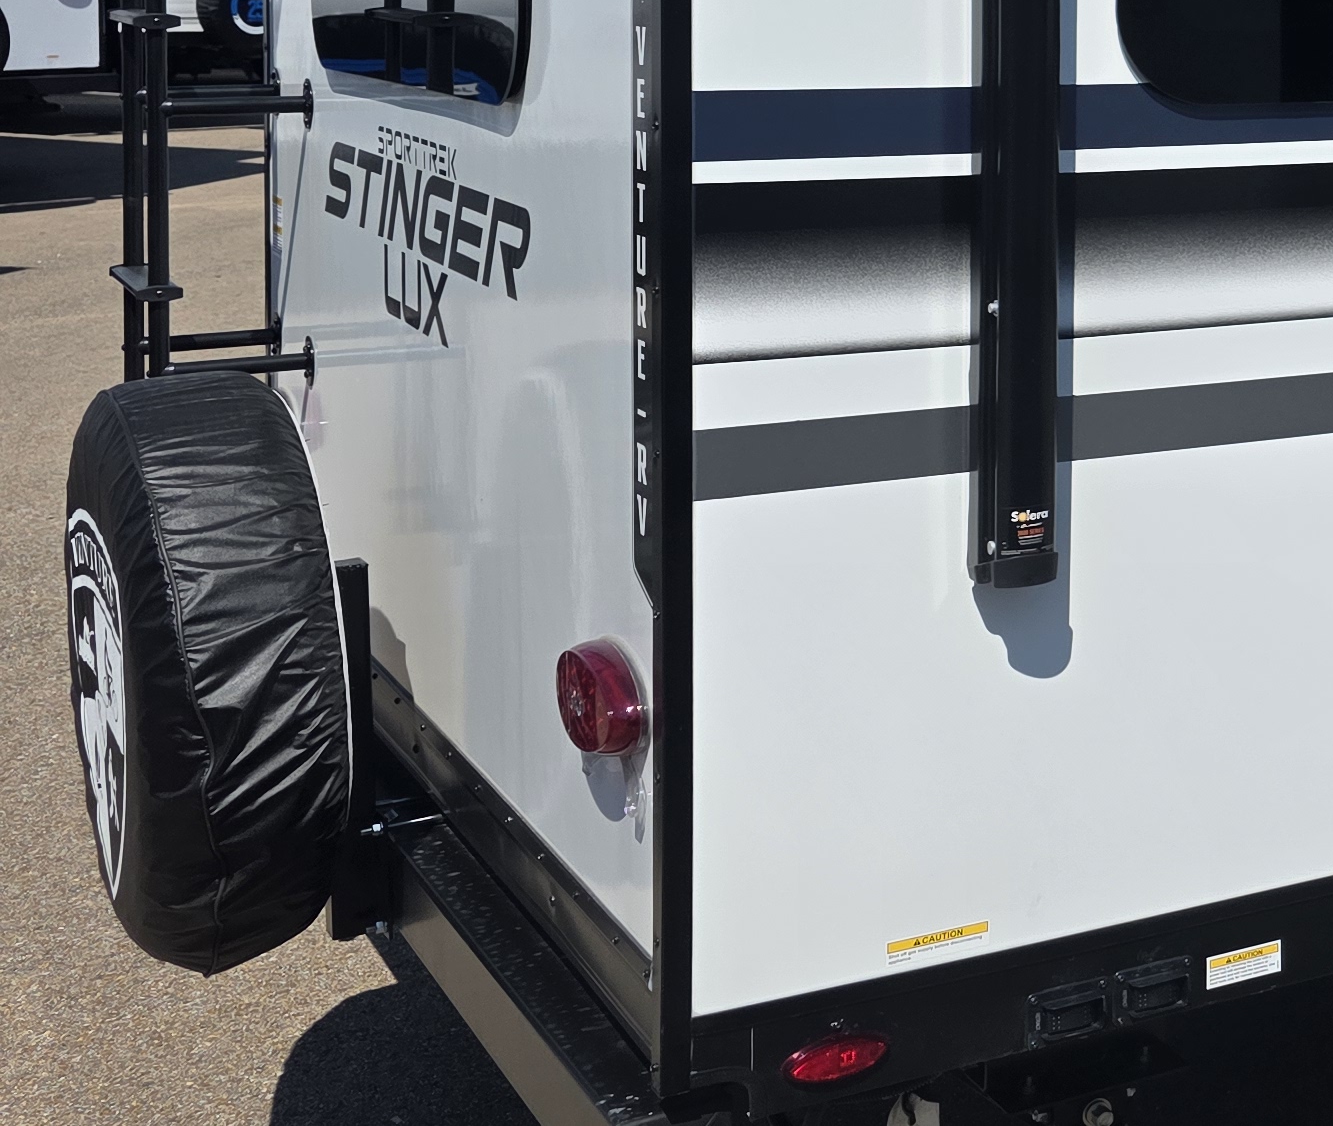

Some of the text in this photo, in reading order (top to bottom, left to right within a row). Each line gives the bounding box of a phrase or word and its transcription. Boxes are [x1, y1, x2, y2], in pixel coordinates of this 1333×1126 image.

[378, 126, 457, 180] SPORTTREK
[325, 141, 531, 301] STINGER
[635, 26, 648, 381] VENTURE
[384, 243, 449, 349] LUX
[636, 442, 648, 537] RV
[1010, 509, 1049, 522] Solera
[922, 929, 963, 944] CAUTION
[1233, 949, 1263, 960] CAUTION
